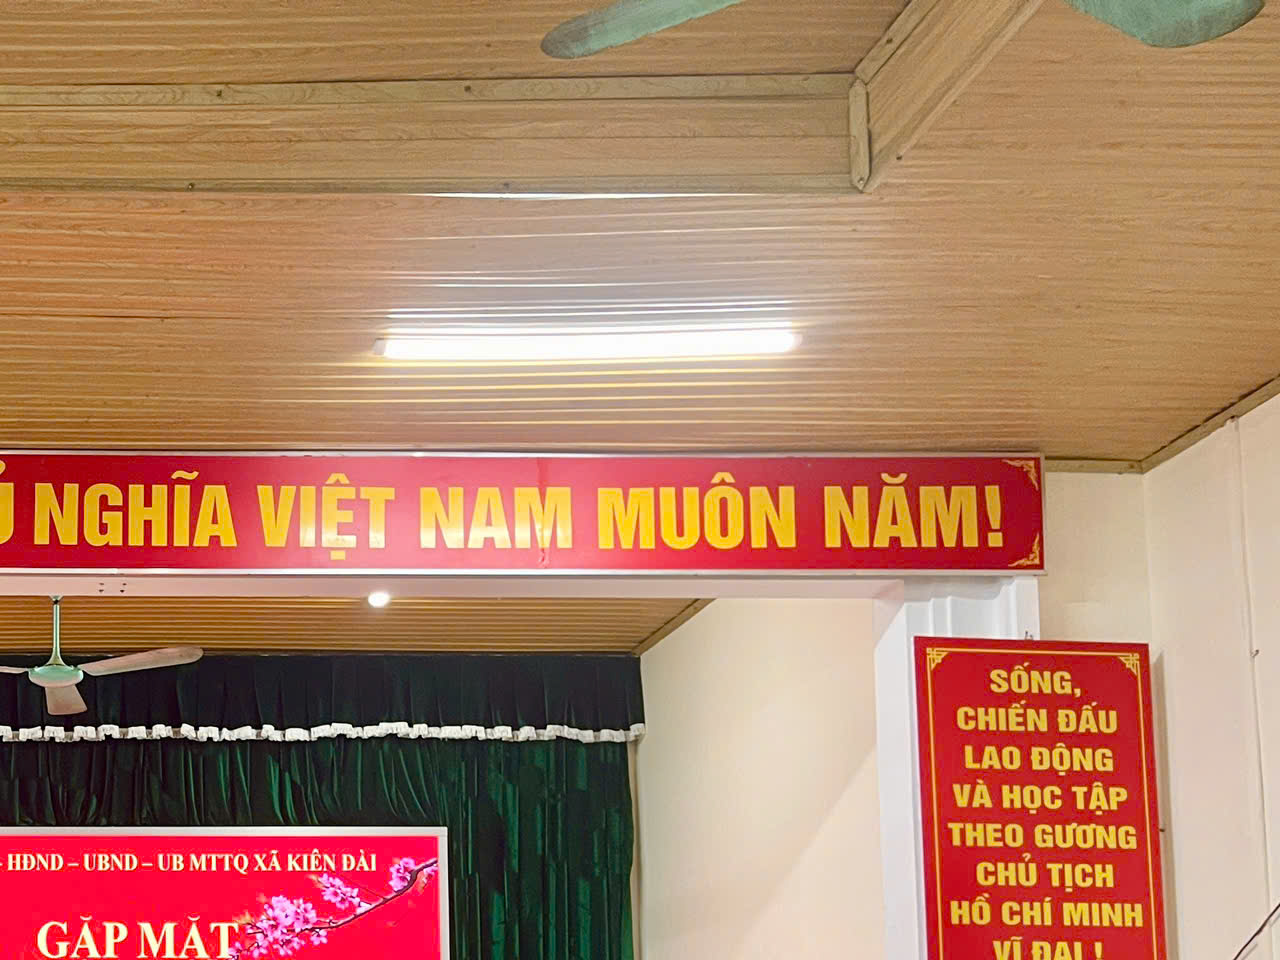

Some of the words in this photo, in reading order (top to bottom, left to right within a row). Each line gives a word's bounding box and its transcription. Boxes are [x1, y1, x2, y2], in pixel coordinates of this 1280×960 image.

[35, 471, 237, 547] NGHĨA
[256, 473, 396, 560] VIỆT
[418, 487, 573, 549] NAM
[597, 472, 797, 549] MUÔN
[825, 474, 1004, 549] NĂM!
[990, 663, 1081, 698] SỐNG,
[957, 700, 1048, 732] CHIẾN
[1058, 702, 1117, 733] ĐẤU
[964, 746, 1021, 770] LAO
[1031, 743, 1113, 776] ĐỘNG
[952, 780, 993, 808] VÀ
[1002, 785, 1062, 814] HỌC
[1072, 782, 1128, 815] TẬP
[948, 823, 1024, 848] THEO
[1035, 824, 1137, 849] GƯƠNG
[7, 853, 64, 871] HĐND
[83, 853, 138, 871] UBND
[158, 853, 185, 871] UB
[189, 853, 249, 874] MTTQ
[254, 850, 282, 871] XÃ
[287, 848, 336, 871] KIÊN
[342, 849, 377, 871] ĐÀI
[976, 853, 1037, 886] CHỦ
[1047, 863, 1114, 892] TỊCH
[950, 893, 990, 925] HỒ
[1002, 897, 1052, 926] CHÍ
[1063, 902, 1143, 927] MINH
